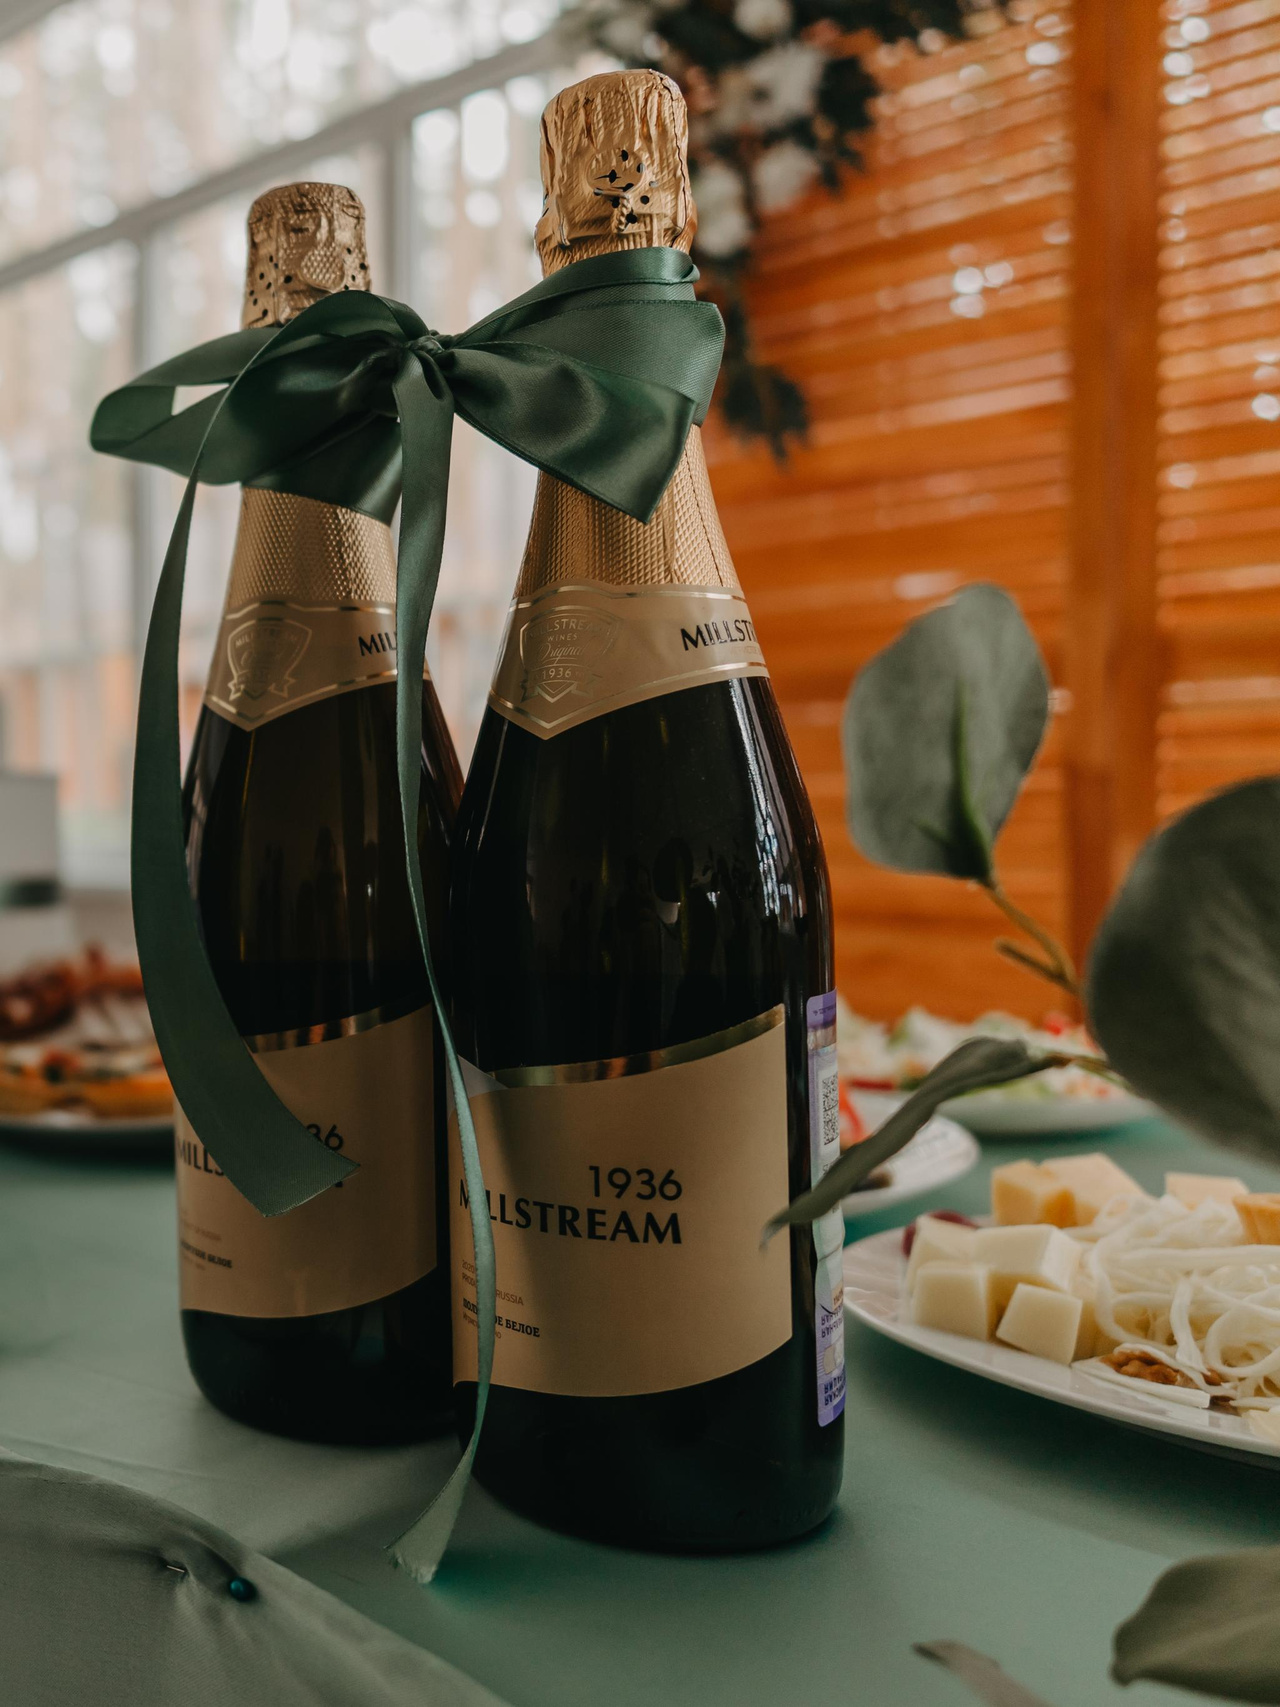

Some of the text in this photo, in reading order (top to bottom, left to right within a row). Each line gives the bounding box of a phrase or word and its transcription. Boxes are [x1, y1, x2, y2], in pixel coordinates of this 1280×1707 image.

[358, 632, 397, 656] MIL
[547, 632, 578, 642] WINES
[541, 667, 572, 680] 1936
[588, 1165, 683, 1201] 1936
[459, 1178, 683, 1245] MLLSTREAM
[495, 1289, 524, 1306] RUSSIA
[505, 1318, 540, 1338] БЕЛОЕ
